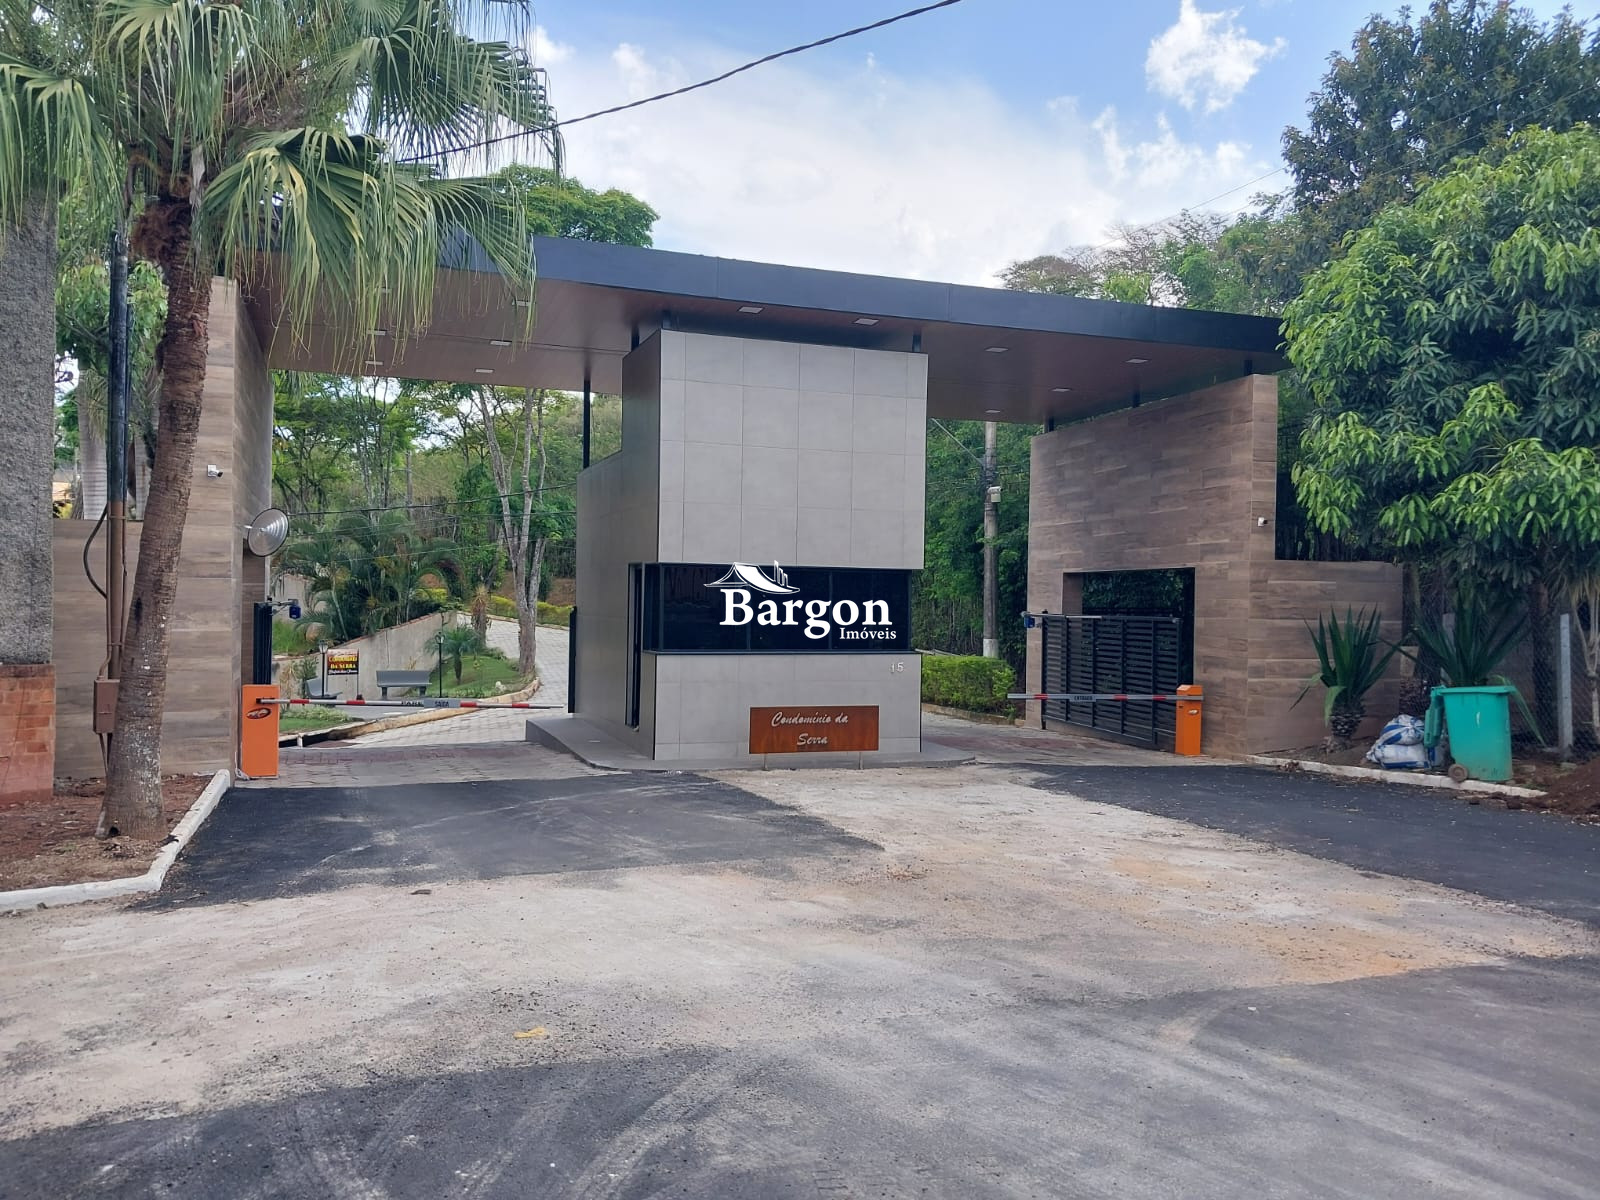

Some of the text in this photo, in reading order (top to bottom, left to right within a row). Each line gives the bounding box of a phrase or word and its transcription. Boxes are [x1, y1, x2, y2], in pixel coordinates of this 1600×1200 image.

[890, 661, 904, 673] 15
[771, 711, 849, 728] Condomínio da
[796, 733, 828, 746] Serra
